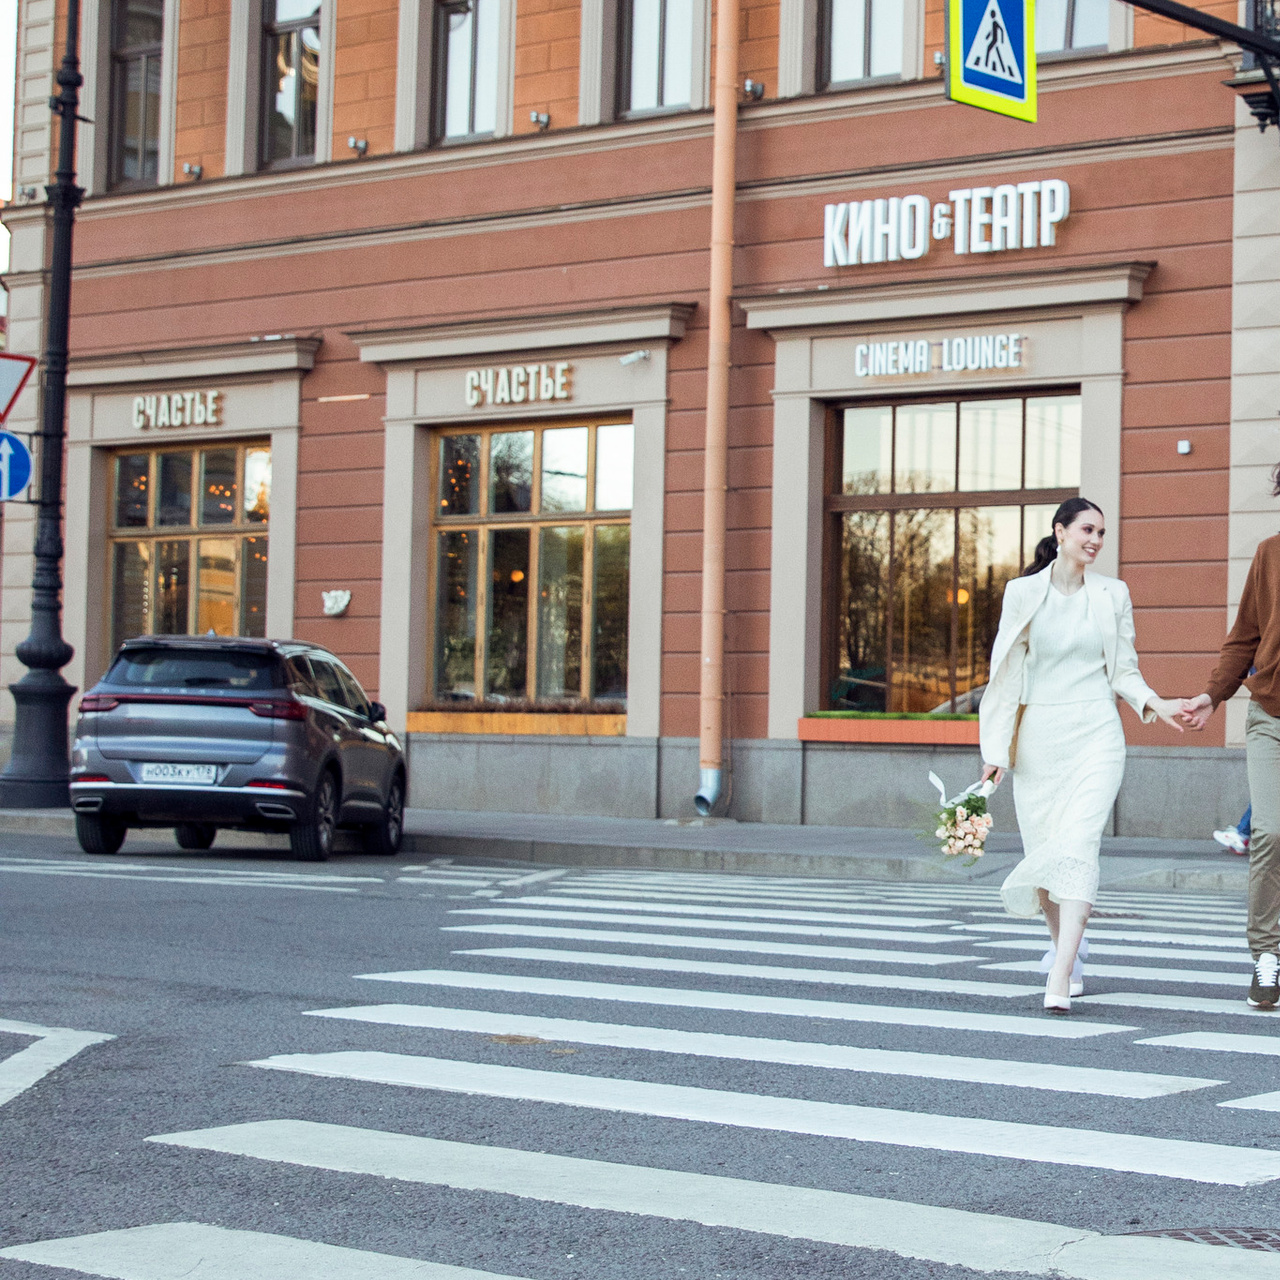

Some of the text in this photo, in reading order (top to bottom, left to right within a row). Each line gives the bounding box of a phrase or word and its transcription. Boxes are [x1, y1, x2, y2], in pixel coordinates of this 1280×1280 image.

[823, 195, 931, 268] КИНО
[948, 178, 1071, 255] ТЕАТР
[854, 331, 1023, 378] CINEMA LOUNGE
[464, 361, 570, 408] СЧАСТЬЕ
[132, 389, 219, 431] СЧАСТЬЕ
